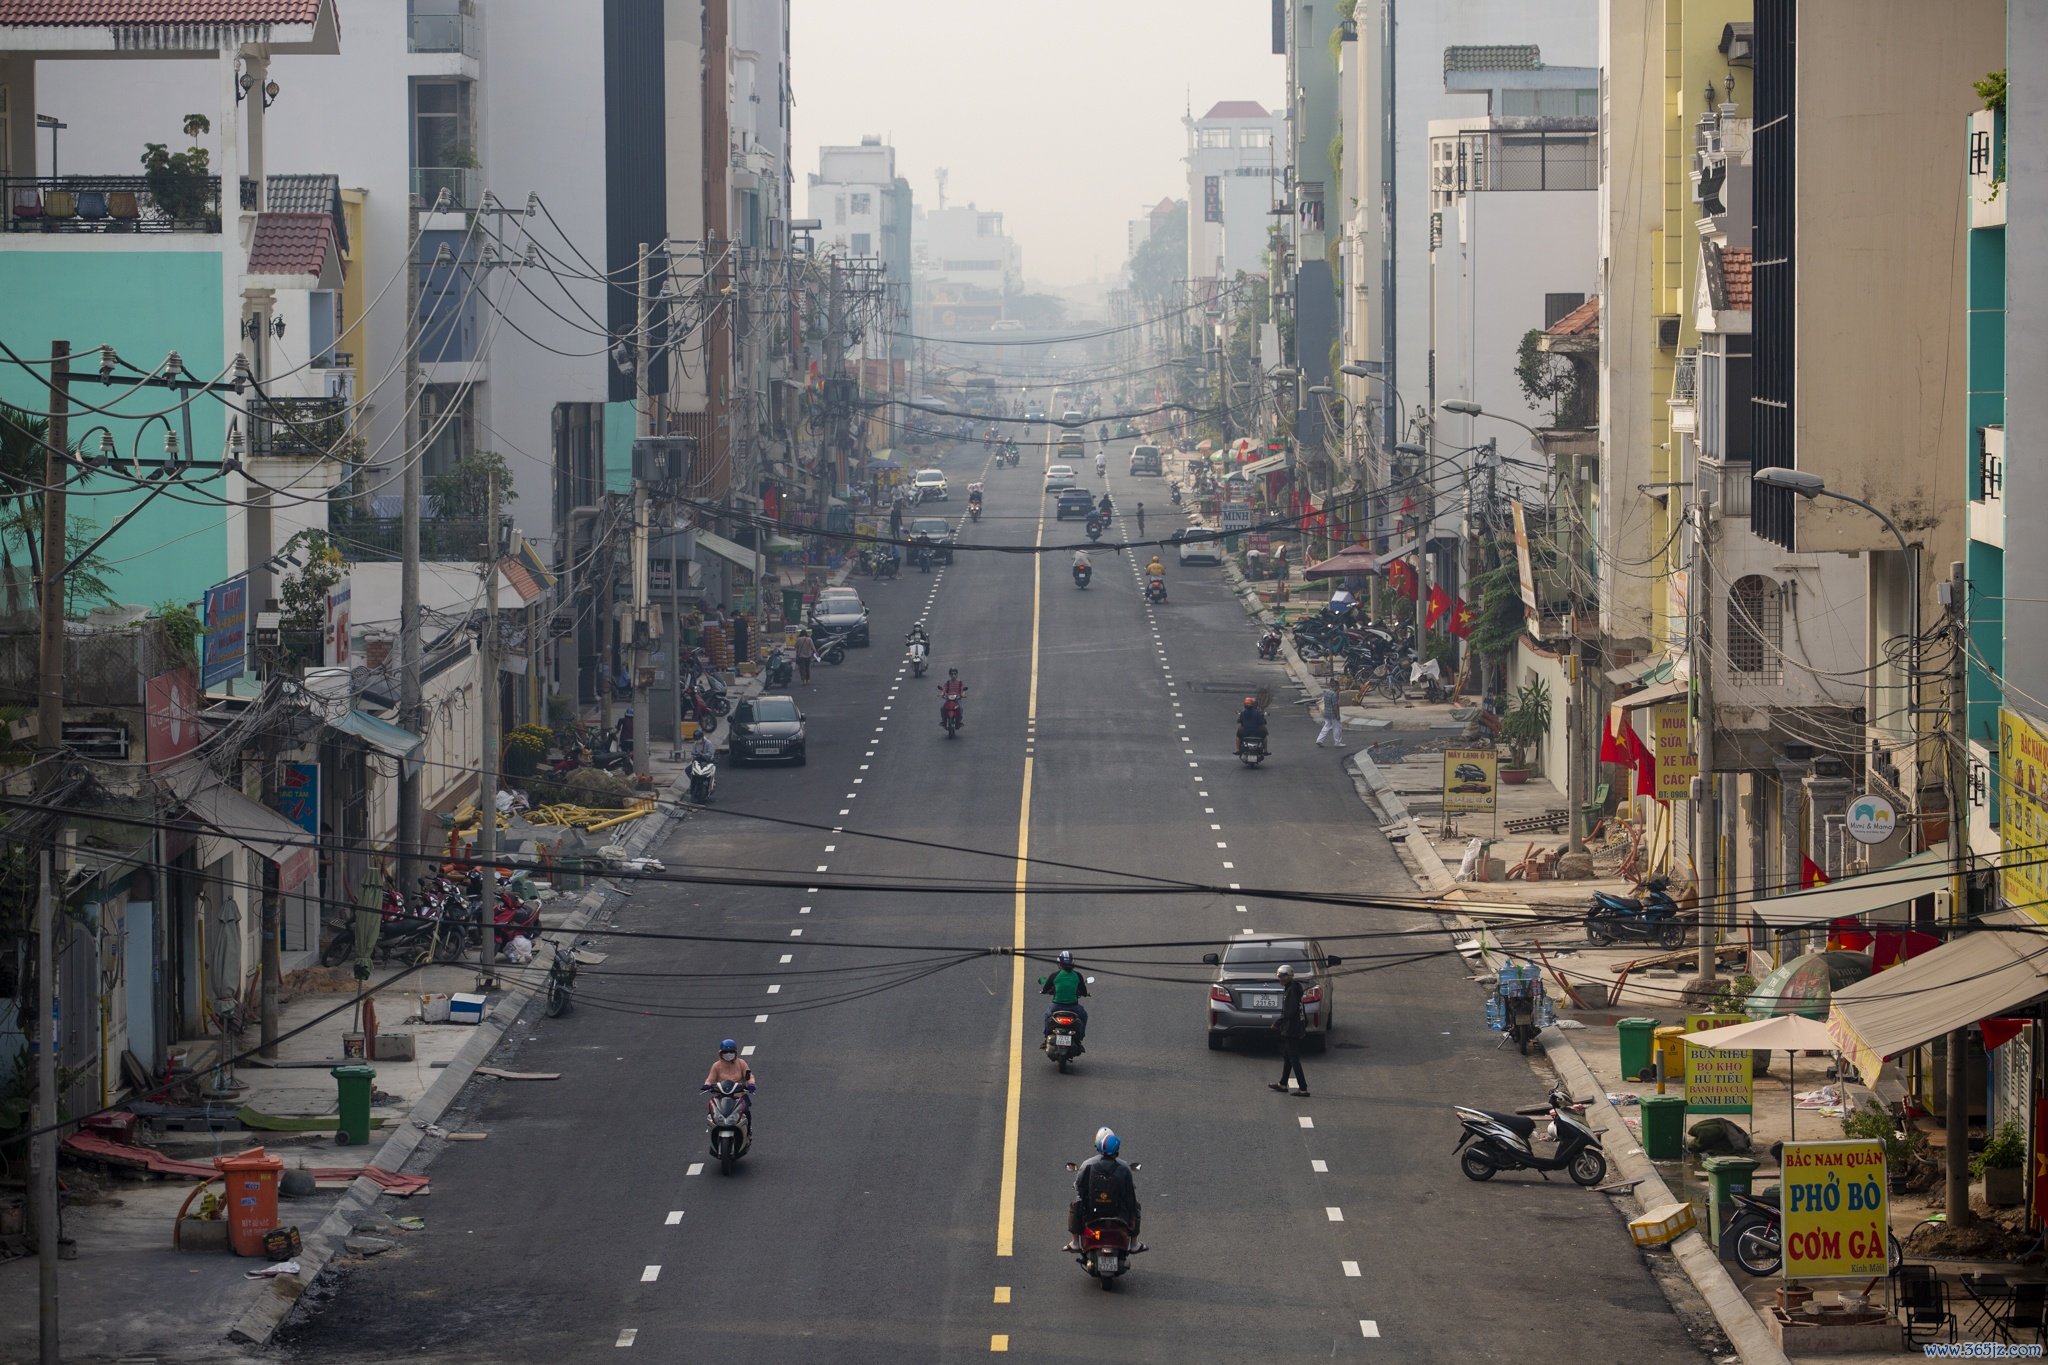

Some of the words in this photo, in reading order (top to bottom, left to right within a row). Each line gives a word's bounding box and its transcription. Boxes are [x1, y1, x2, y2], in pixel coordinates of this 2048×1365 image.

[1207, 178, 1217, 220] HOTEL
[1223, 512, 1249, 521] MINH
[1662, 718, 1687, 729] MUA
[1663, 755, 1676, 766] XE
[1663, 772, 1685, 785] CÁC
[1717, 1062, 1742, 1071] KHO
[1690, 1095, 1721, 1104] CANH
[1724, 1093, 1748, 1104] BÚN
[1786, 1148, 1811, 1167] BẮC
[1815, 1153, 1843, 1166] NAM
[1847, 1149, 1883, 1168] QUÁN
[1790, 1171, 1840, 1212] PHỞ
[1847, 1174, 1881, 1210] BÒ
[1788, 1226, 1841, 1260] CƠM
[1848, 1222, 1885, 1259] GÀ
